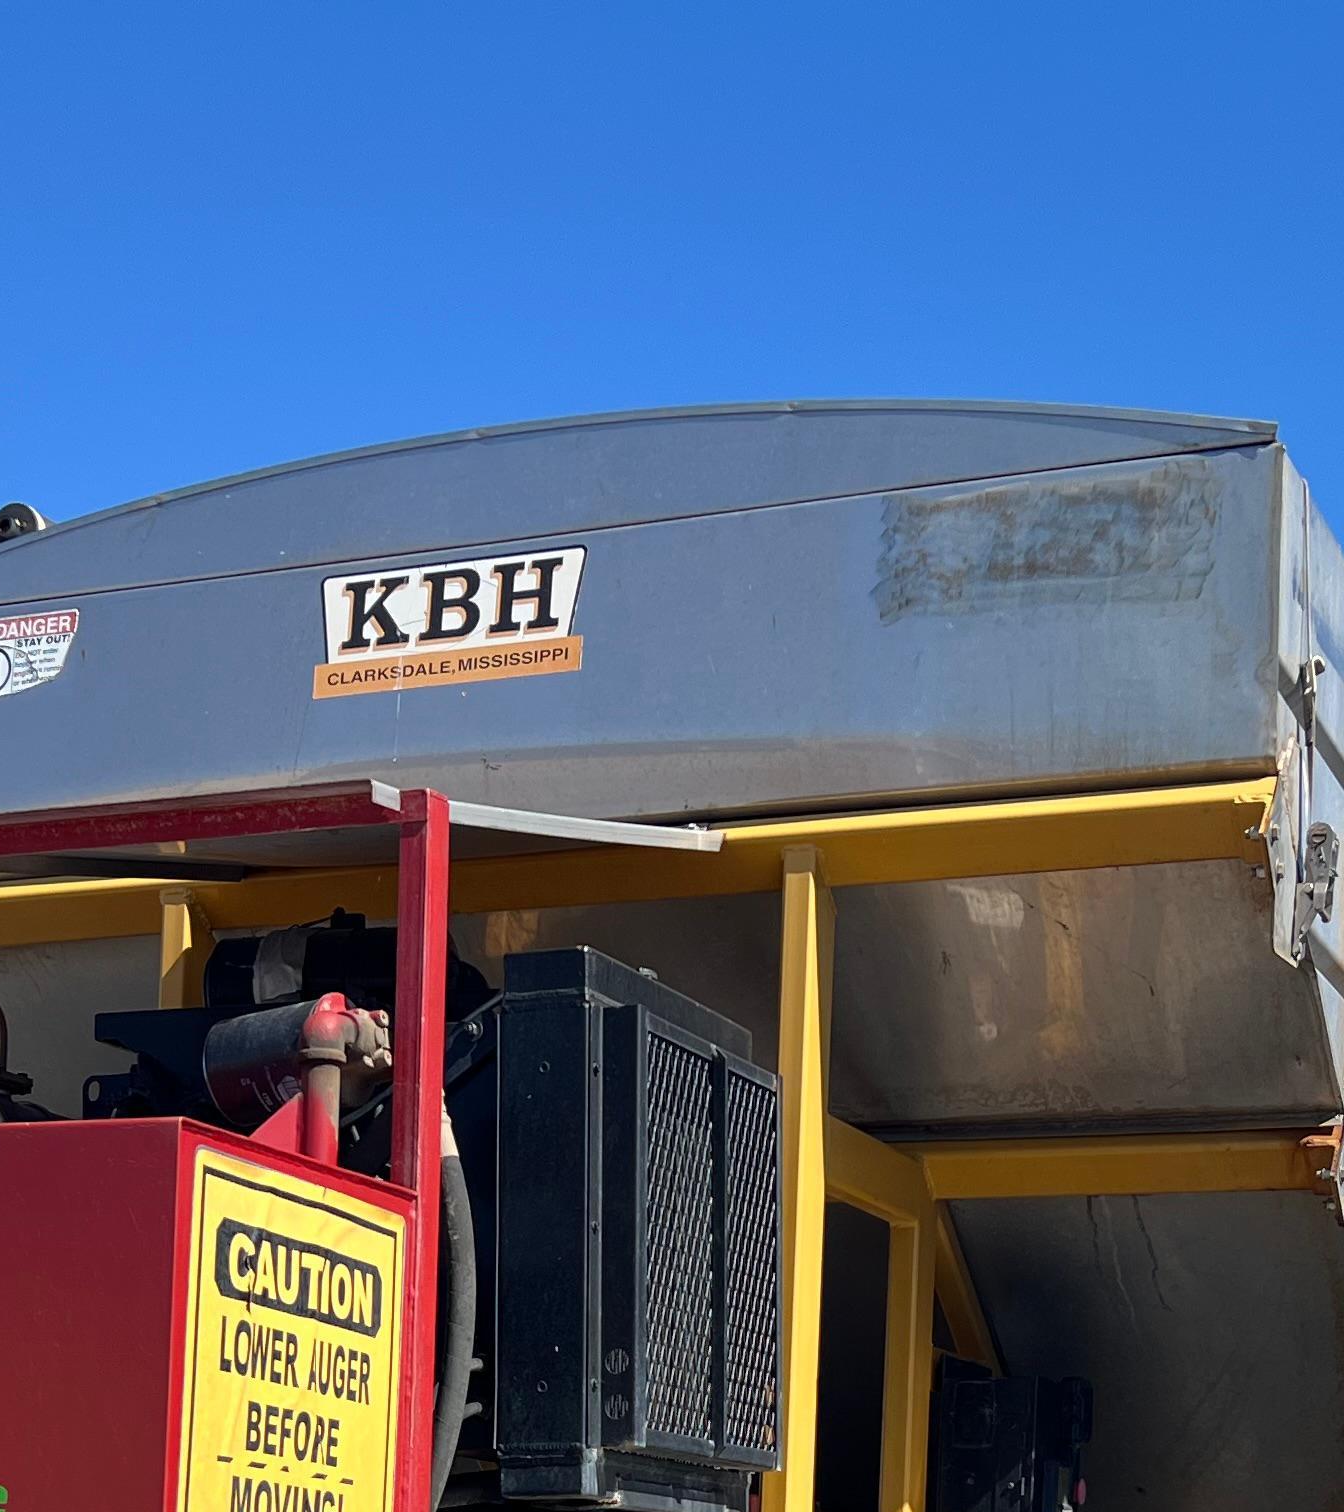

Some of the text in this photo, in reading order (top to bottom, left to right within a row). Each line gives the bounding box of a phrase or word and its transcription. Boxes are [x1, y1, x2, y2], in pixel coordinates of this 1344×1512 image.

[17, 636, 43, 648] STAY
[338, 556, 564, 655] KBH
[327, 647, 569, 687] CLARKSDALE, MISSISSIPPI
[229, 1232, 374, 1328] CAUTION
[219, 1315, 372, 1406] LOWER AUGER
[245, 1400, 340, 1468] BEFORE
